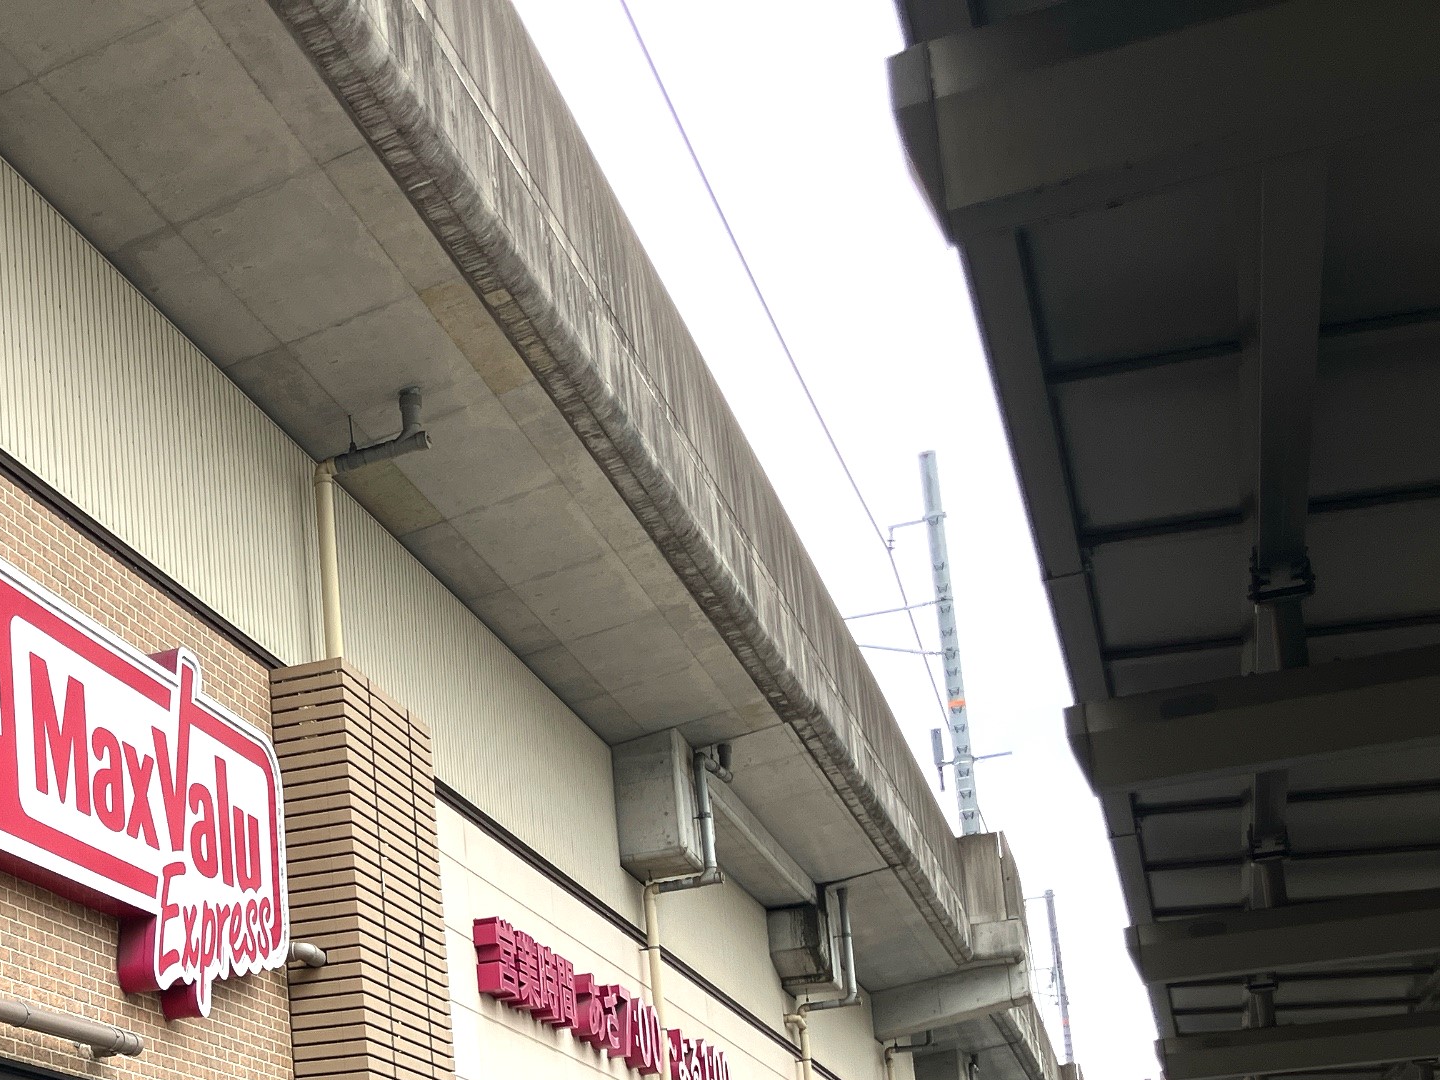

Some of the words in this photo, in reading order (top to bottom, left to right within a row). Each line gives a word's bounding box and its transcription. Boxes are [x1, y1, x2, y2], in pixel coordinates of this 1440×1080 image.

[29, 663, 262, 894] MaxValu
[158, 861, 271, 1003] Express
[478, 917, 579, 1030] 営業時間
